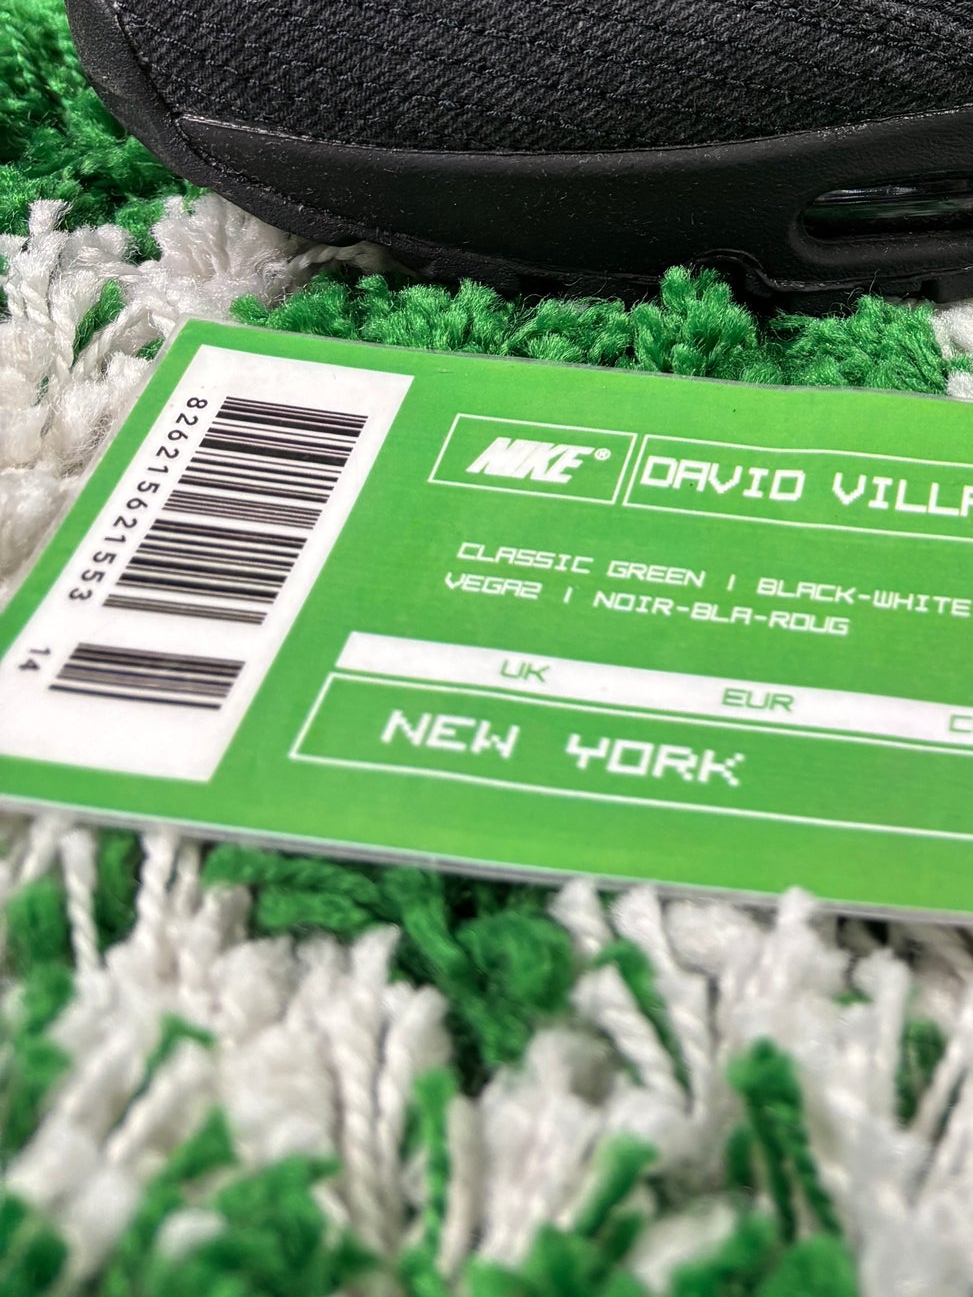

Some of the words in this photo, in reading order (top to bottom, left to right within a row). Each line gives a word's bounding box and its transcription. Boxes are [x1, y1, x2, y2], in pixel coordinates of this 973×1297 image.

[465, 436, 595, 484] NIKE
[640, 455, 806, 502] DAVID
[69, 397, 208, 601] 826215621553
[457, 542, 594, 574] CLASSIC
[607, 560, 705, 587] GREEN
[593, 590, 850, 636] NOIR-BLA-ROUG
[19, 647, 50, 671] 14
[500, 659, 551, 683] UK
[722, 687, 794, 712] EUR
[381, 709, 520, 759] NEW
[566, 733, 745, 787] YORK
